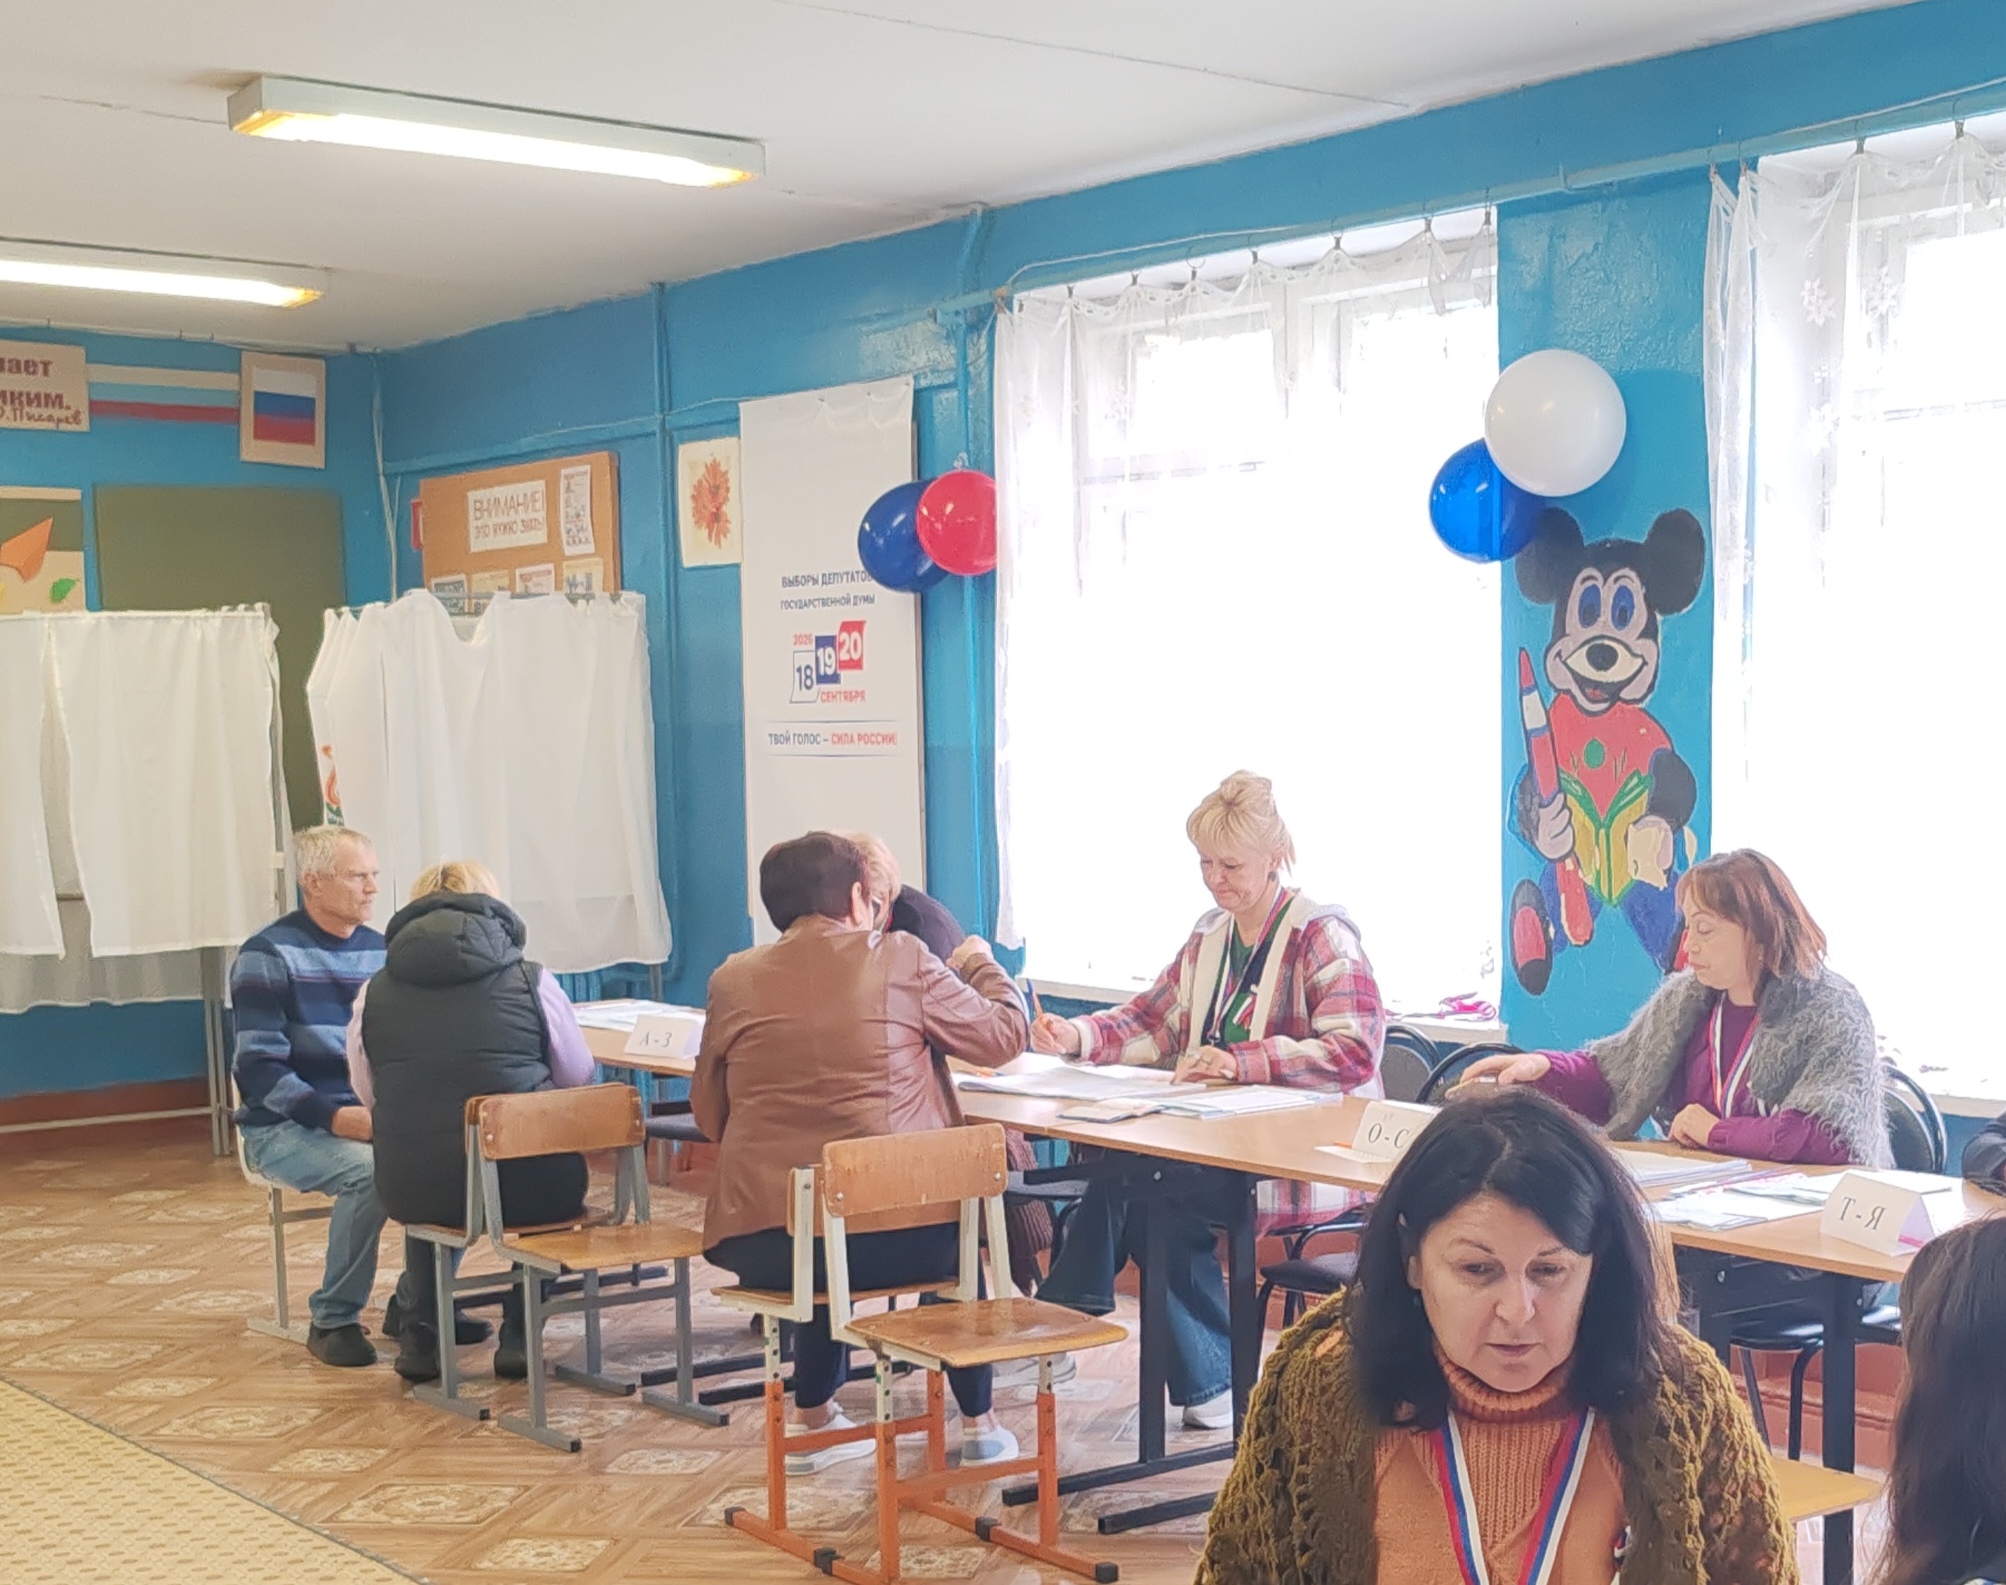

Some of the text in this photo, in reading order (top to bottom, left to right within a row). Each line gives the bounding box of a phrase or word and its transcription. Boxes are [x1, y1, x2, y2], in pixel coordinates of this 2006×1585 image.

[782, 574, 820, 588] ВЫБОРЫ
[780, 593, 875, 610] ГОСУДАРСТВЕННОЙ ДУМЫ
[793, 634, 814, 645] 2026
[796, 631, 862, 691] 18 19 20
[820, 690, 866, 703] СЕНТЯБРЯ
[768, 731, 792, 745] ТВОЙ
[793, 733, 822, 745] ГОЛОС
[831, 733, 855, 745] СИЛА
